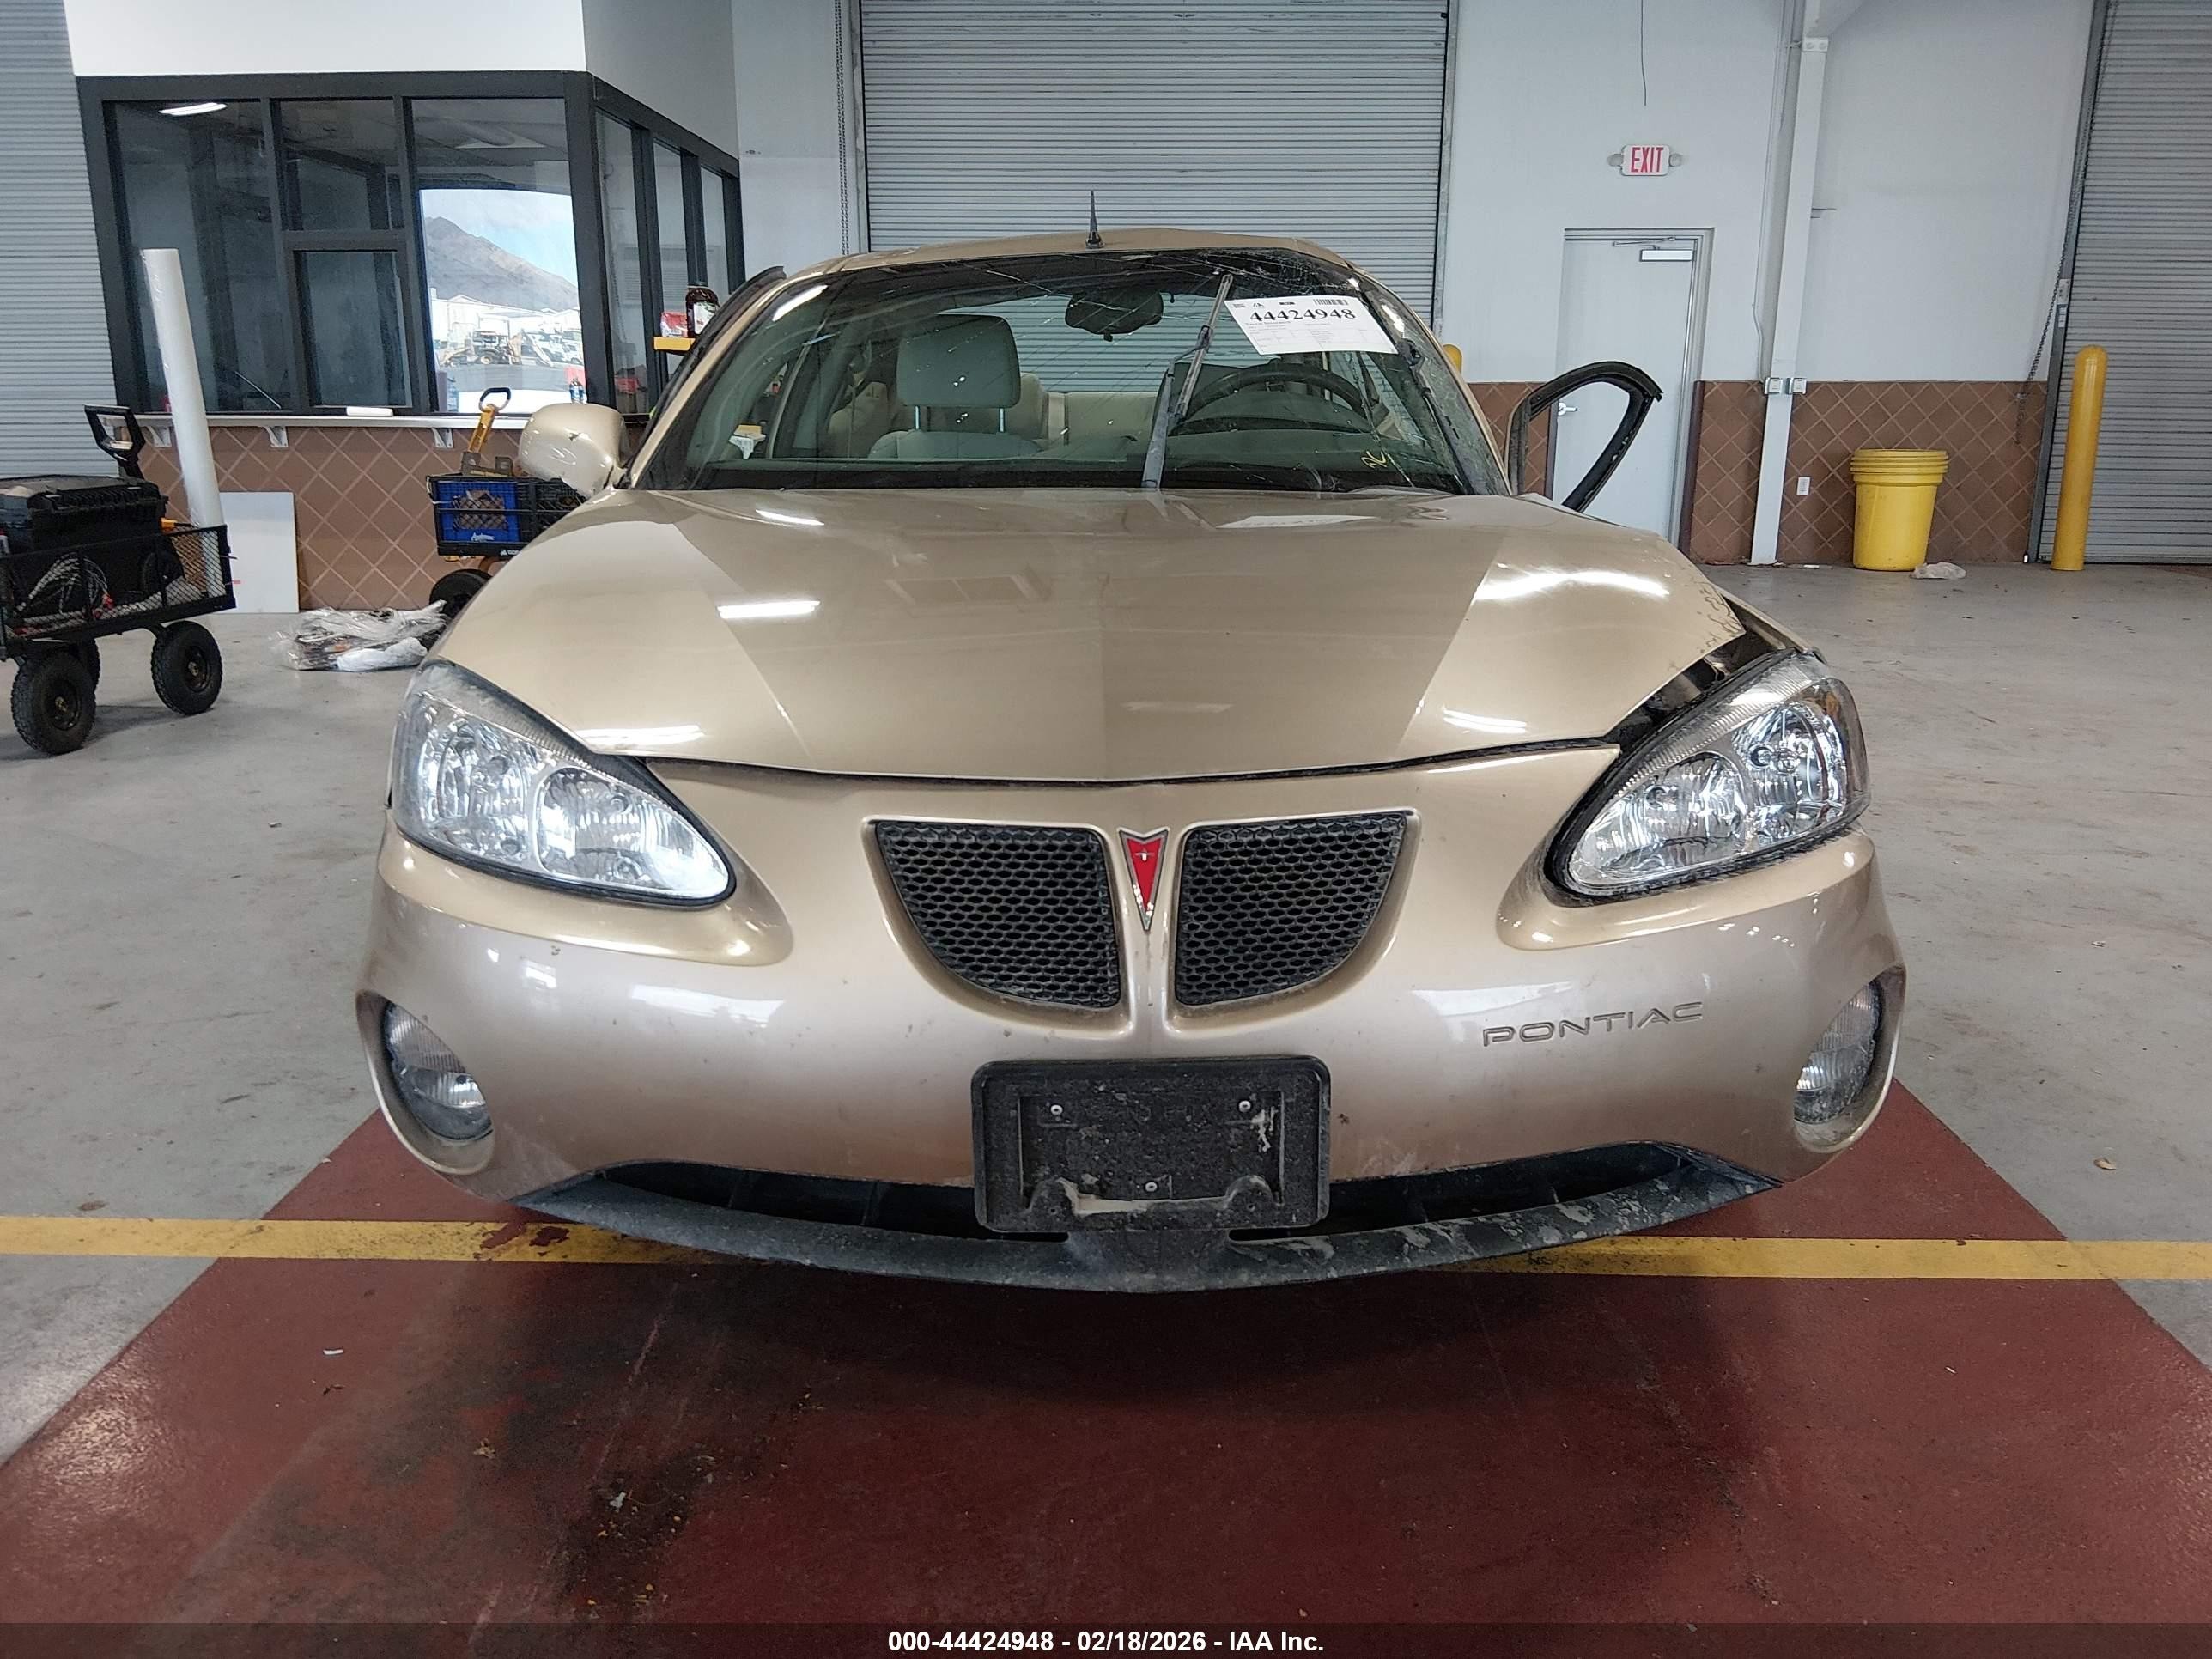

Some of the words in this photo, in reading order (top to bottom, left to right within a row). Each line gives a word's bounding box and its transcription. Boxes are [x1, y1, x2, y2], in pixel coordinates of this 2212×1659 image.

[1630, 146, 1664, 173] EXIT
[1249, 308, 1356, 322] 44424948
[1482, 1001, 1704, 1047] PONTIAC
